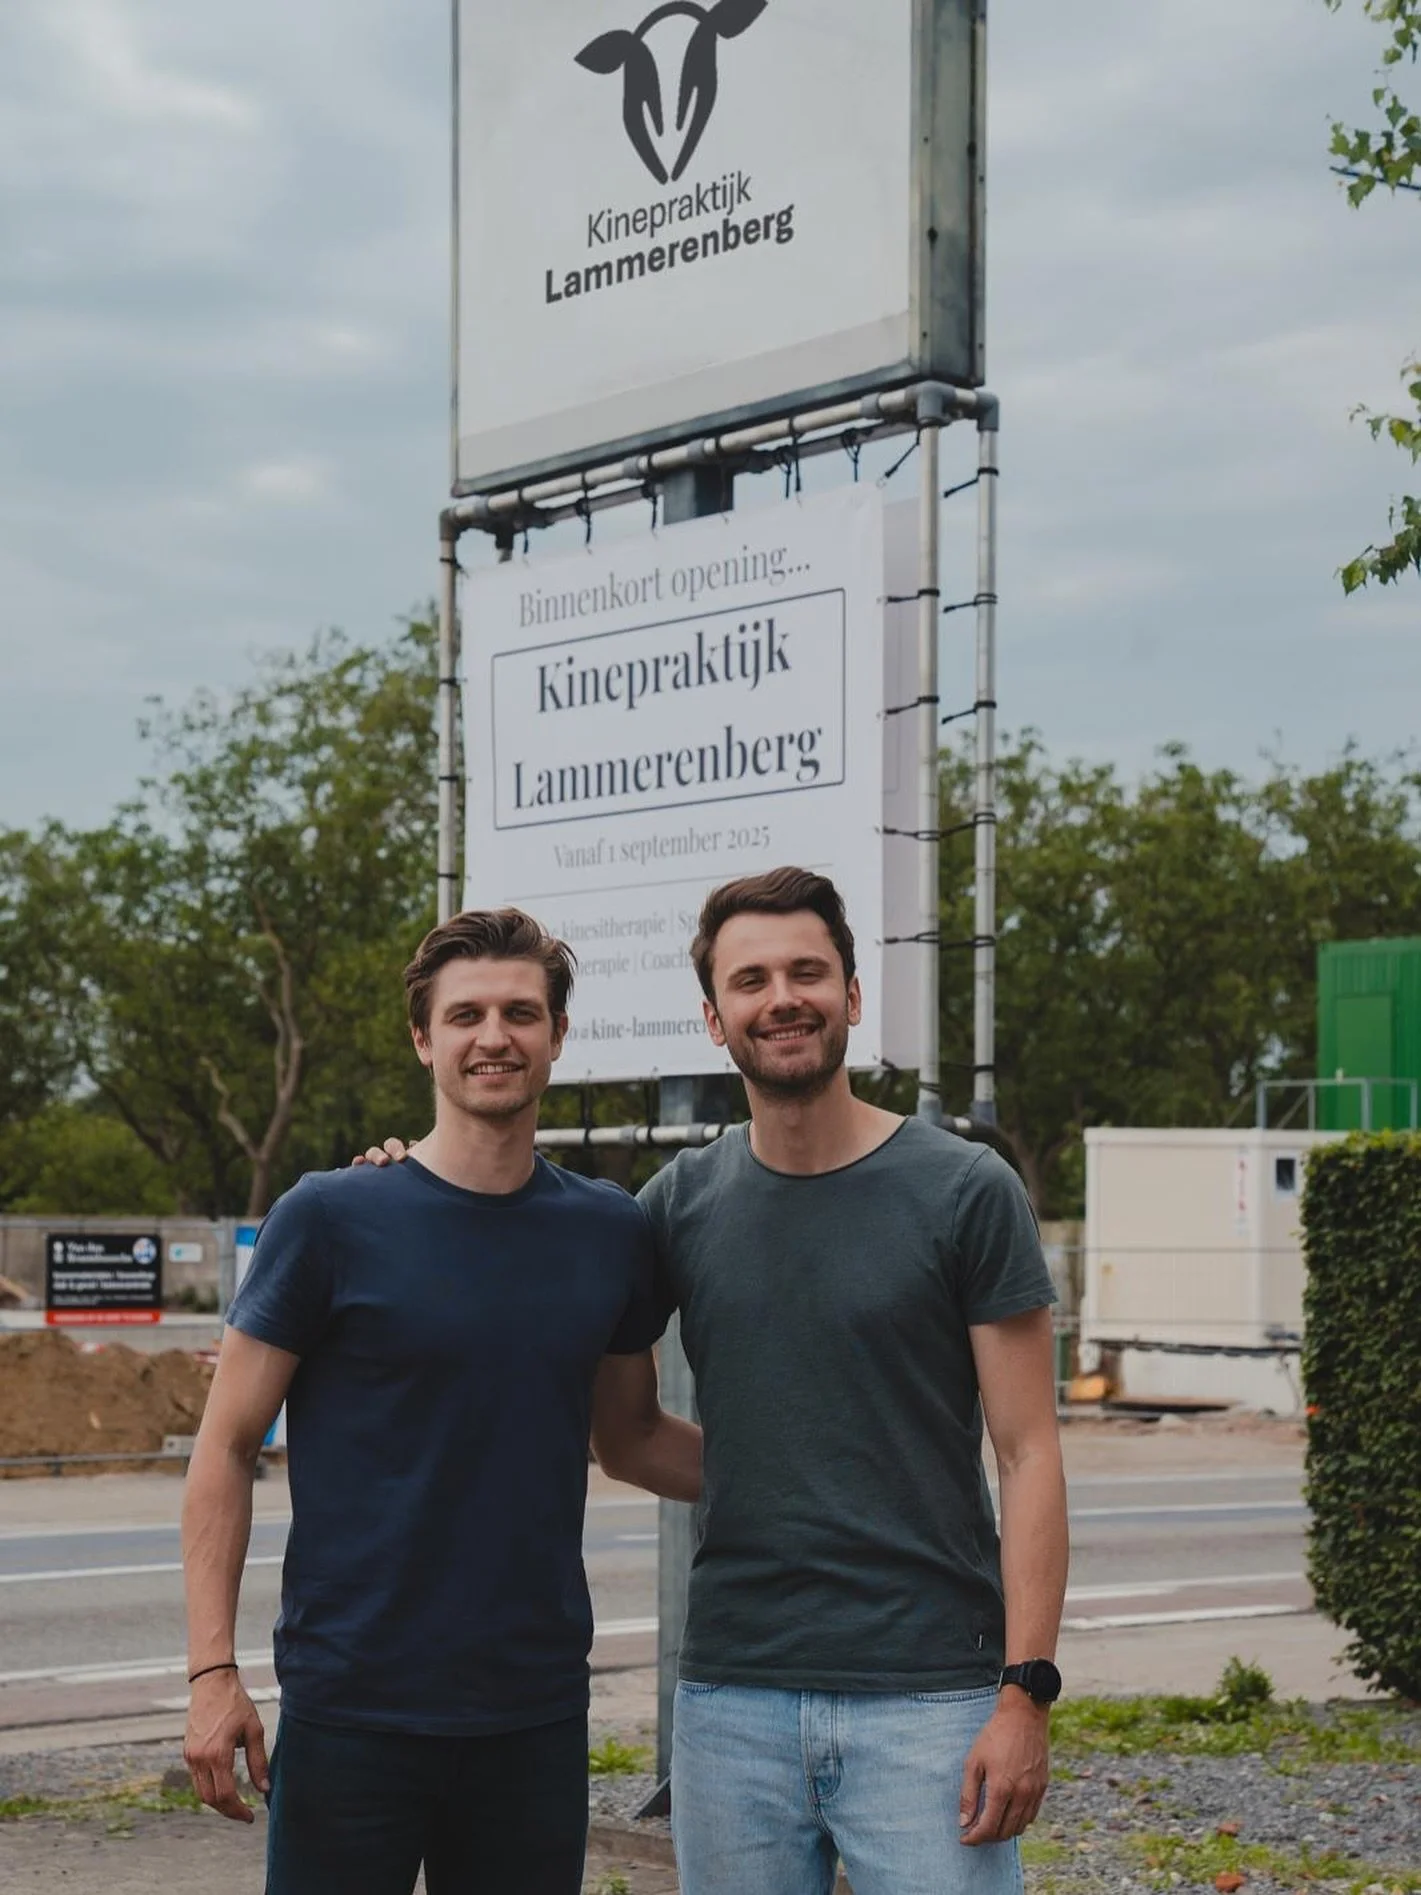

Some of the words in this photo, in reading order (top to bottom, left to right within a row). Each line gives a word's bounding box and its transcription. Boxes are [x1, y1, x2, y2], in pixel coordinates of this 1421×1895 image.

[587, 170, 752, 249] Kinepraktijk
[545, 204, 795, 304] Lammerenberg
[519, 568, 663, 628] Binnenkort
[671, 545, 811, 602] opening...
[537, 617, 792, 714] Kinepraktijk
[513, 724, 823, 810] Lammerenberg
[554, 838, 604, 869] Vanaf
[609, 845, 616, 863] 1
[620, 827, 722, 866] september
[727, 826, 771, 849] 2025
[562, 911, 666, 941] kinesitherapie
